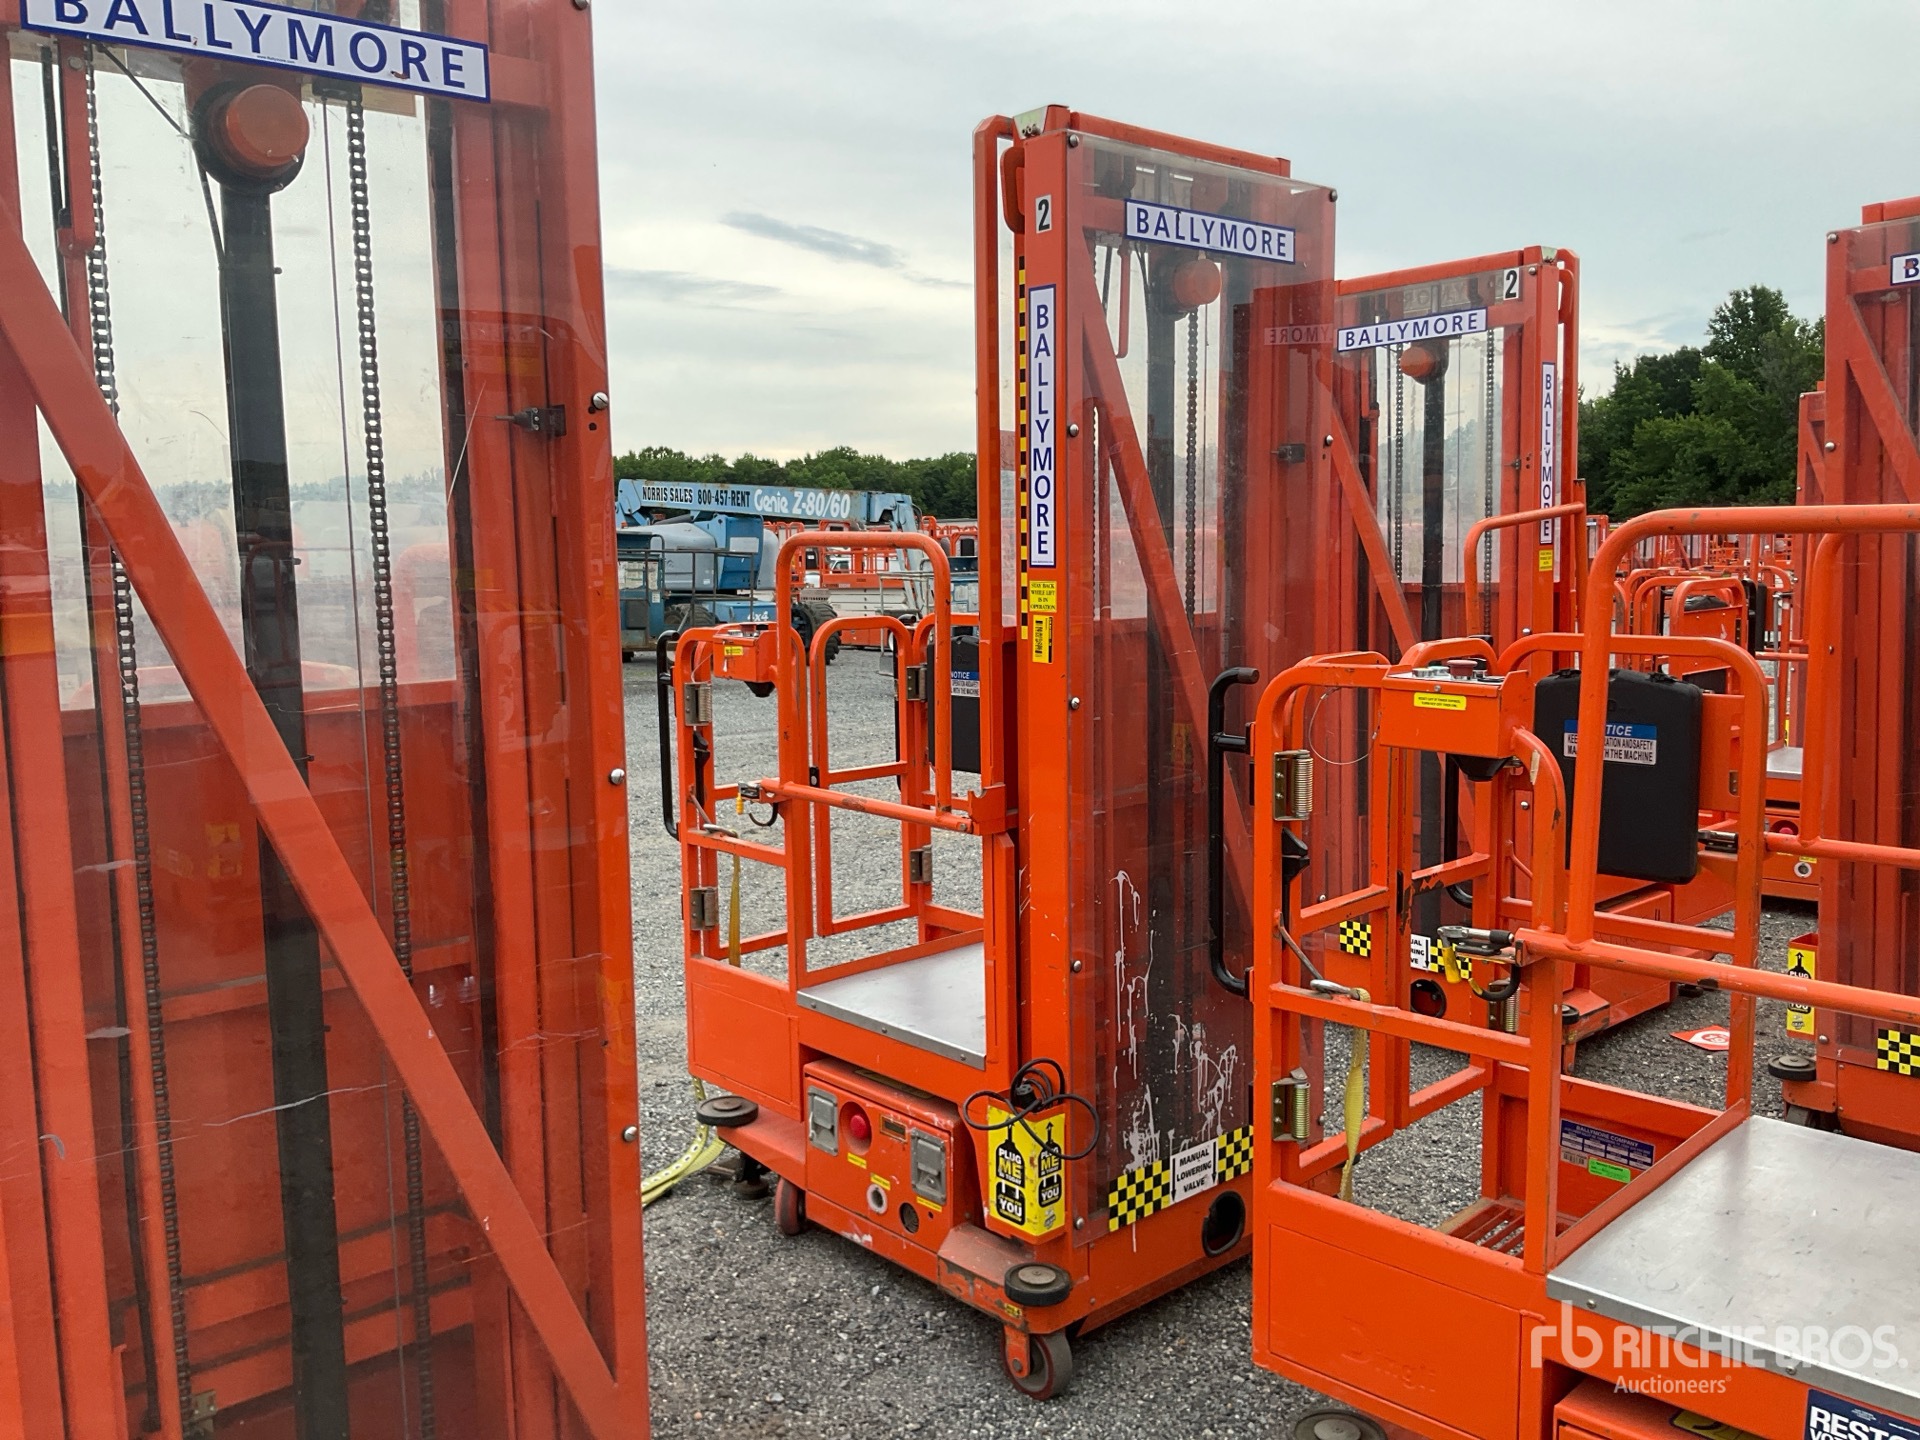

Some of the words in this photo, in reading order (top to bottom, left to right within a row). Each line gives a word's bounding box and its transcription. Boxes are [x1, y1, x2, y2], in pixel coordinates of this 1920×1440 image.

[55, 0, 466, 88] BALLYMORE
[1038, 199, 1050, 231] 2
[1136, 207, 1286, 257] BALLYMORE
[1505, 270, 1517, 298] 2
[1345, 313, 1478, 347] BALLYMORE
[1033, 304, 1052, 554] BALLYMORE
[642, 486, 668, 502] NORRIS
[669, 488, 693, 504] SALES
[697, 489, 750, 508] 800-457-RENT
[754, 489, 789, 514] Genie
[792, 491, 850, 519] Z-80/60
[1568, 734, 1577, 744] KEE
[1606, 724, 1632, 736] TICE
[1610, 749, 1622, 759] THE
[1624, 750, 1653, 762] MACHINE
[999, 1147, 1022, 1165] PLUG
[1042, 1155, 1059, 1171] ME
[1180, 1149, 1209, 1167] MANUAL
[1000, 1157, 1022, 1178] ME
[1177, 1160, 1212, 1182] LOWERING
[1042, 1187, 1059, 1201] YOU
[1183, 1177, 1206, 1192] VALVE
[1000, 1198, 1022, 1217] YOU
